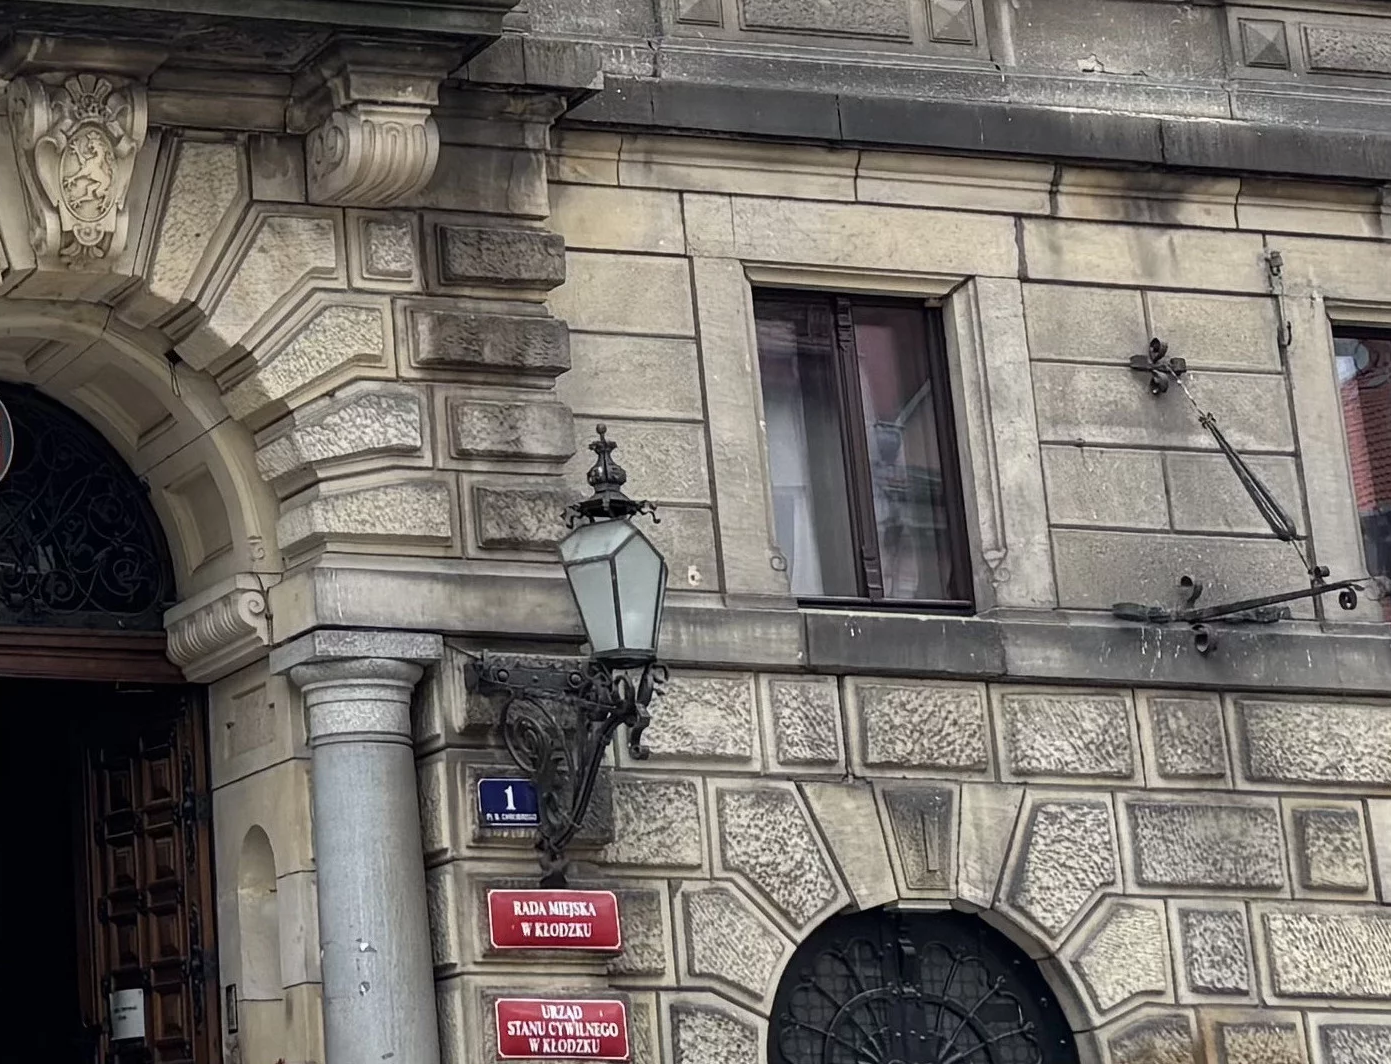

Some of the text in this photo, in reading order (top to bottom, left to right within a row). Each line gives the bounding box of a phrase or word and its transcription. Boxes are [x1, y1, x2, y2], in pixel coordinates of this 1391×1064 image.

[504, 785, 516, 810] 1
[512, 900, 597, 918] RADA MIEJSKA
[520, 922, 592, 938] W KŁODZKU
[541, 1004, 583, 1022] URZĄD
[507, 1020, 619, 1037] STANU CYWILNEGO
[528, 1038, 600, 1054] W KŁODZKU
